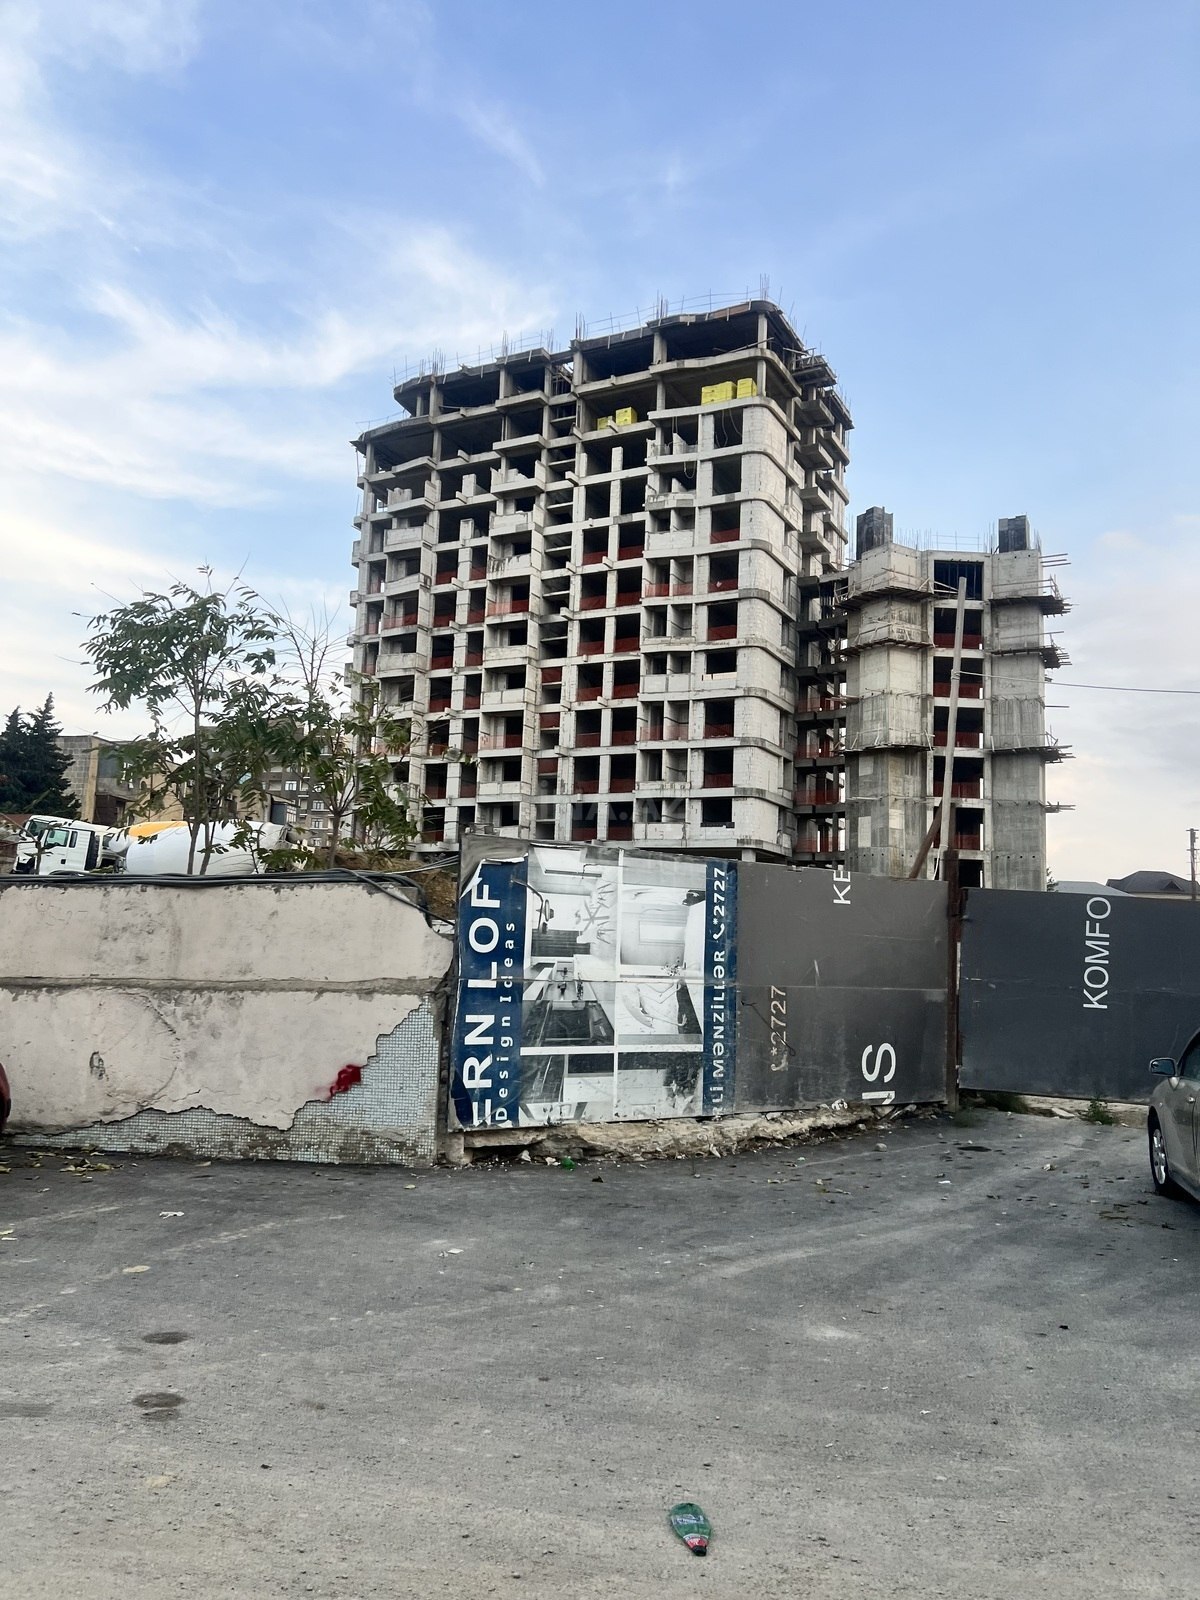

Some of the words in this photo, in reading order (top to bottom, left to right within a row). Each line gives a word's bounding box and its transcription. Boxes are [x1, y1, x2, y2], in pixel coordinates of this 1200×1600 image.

[468, 884, 500, 988] LOF
[833, 870, 851, 905] KE
[500, 922, 516, 1003] Ideas
[1083, 896, 1111, 1009] KOMFO
[495, 1016, 513, 1121] Design
